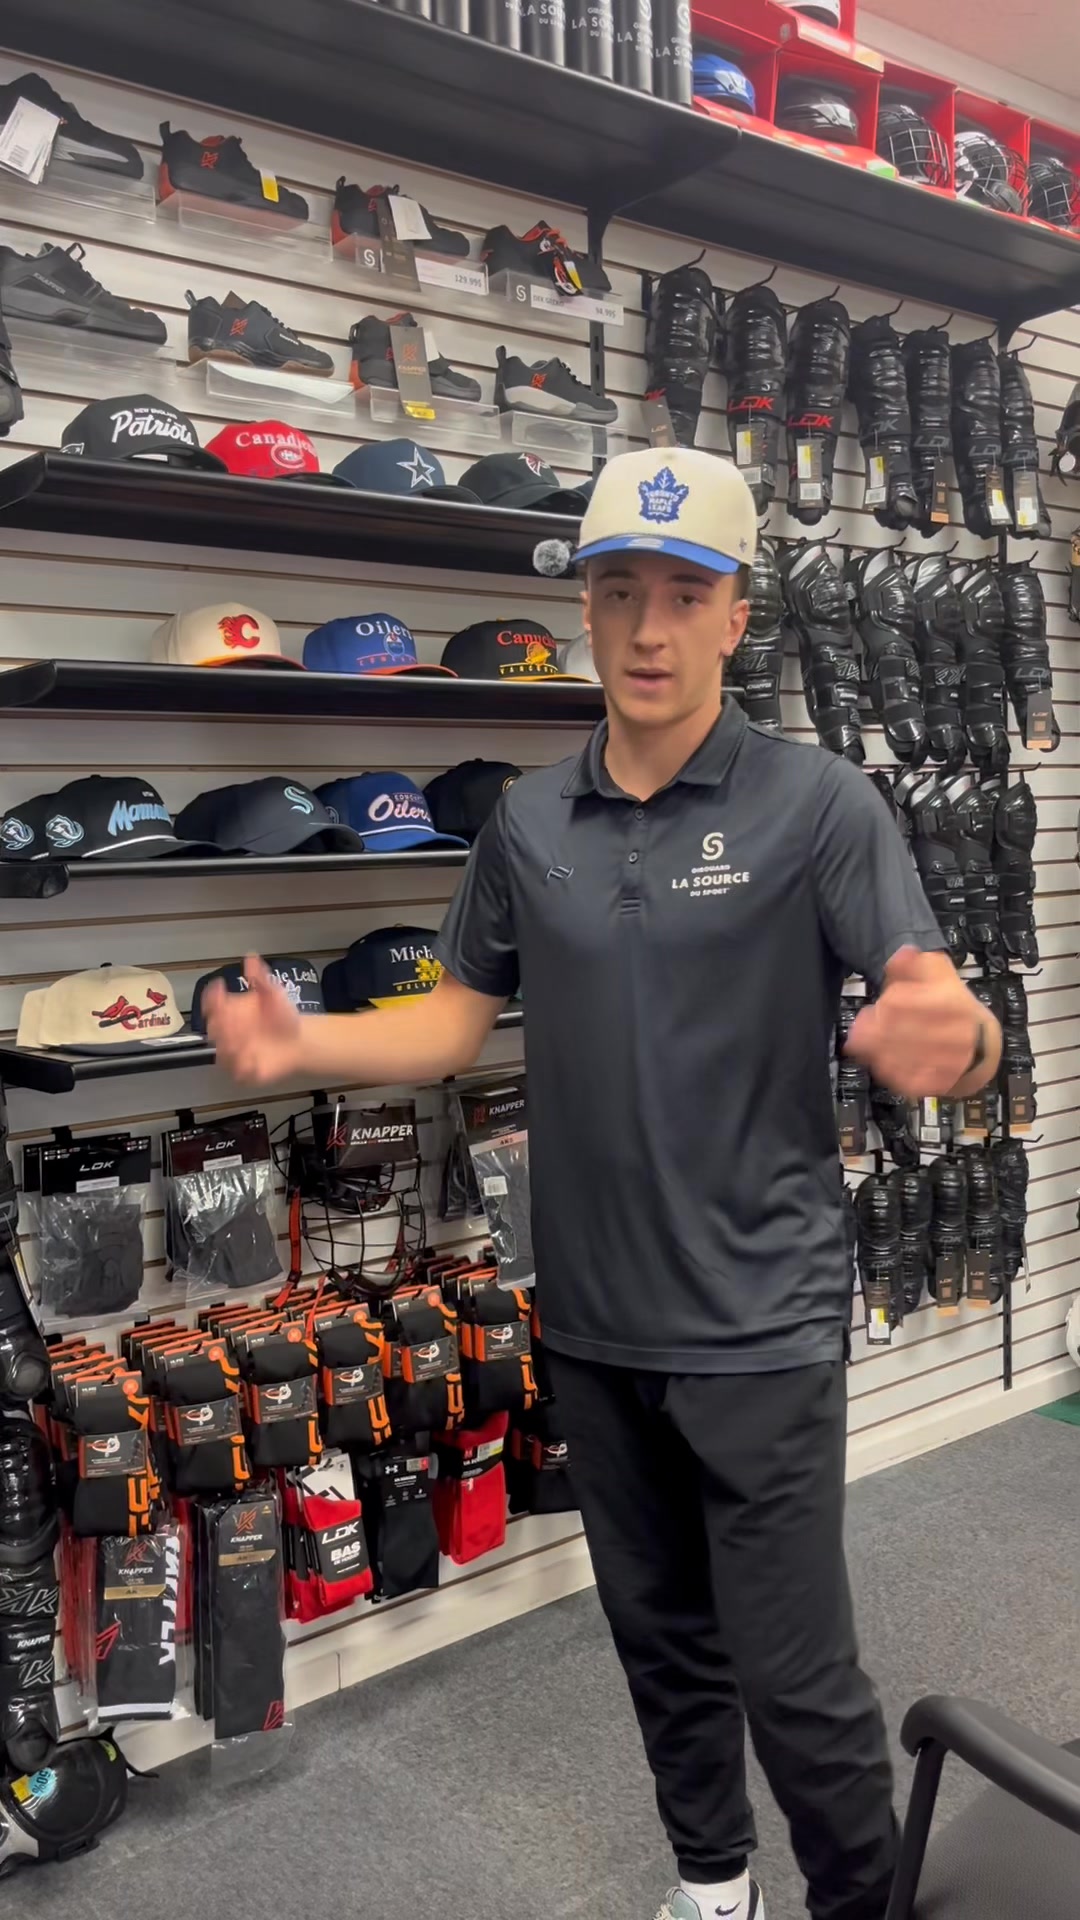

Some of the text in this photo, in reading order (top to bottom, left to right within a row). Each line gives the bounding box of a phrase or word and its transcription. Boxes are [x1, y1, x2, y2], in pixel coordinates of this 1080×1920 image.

[571, 17, 587, 29] LA
[617, 31, 633, 43] LA
[655, 45, 671, 57] LA
[109, 409, 195, 445] Patriots
[671, 871, 750, 889] LA SOURCE
[489, 1099, 525, 1116] KNAPPER
[351, 1124, 413, 1141] KNAPPER
[331, 1541, 361, 1562] BAS
[118, 1566, 153, 1575] KNAPPER
[17, 1634, 51, 1648] KNAPPER
